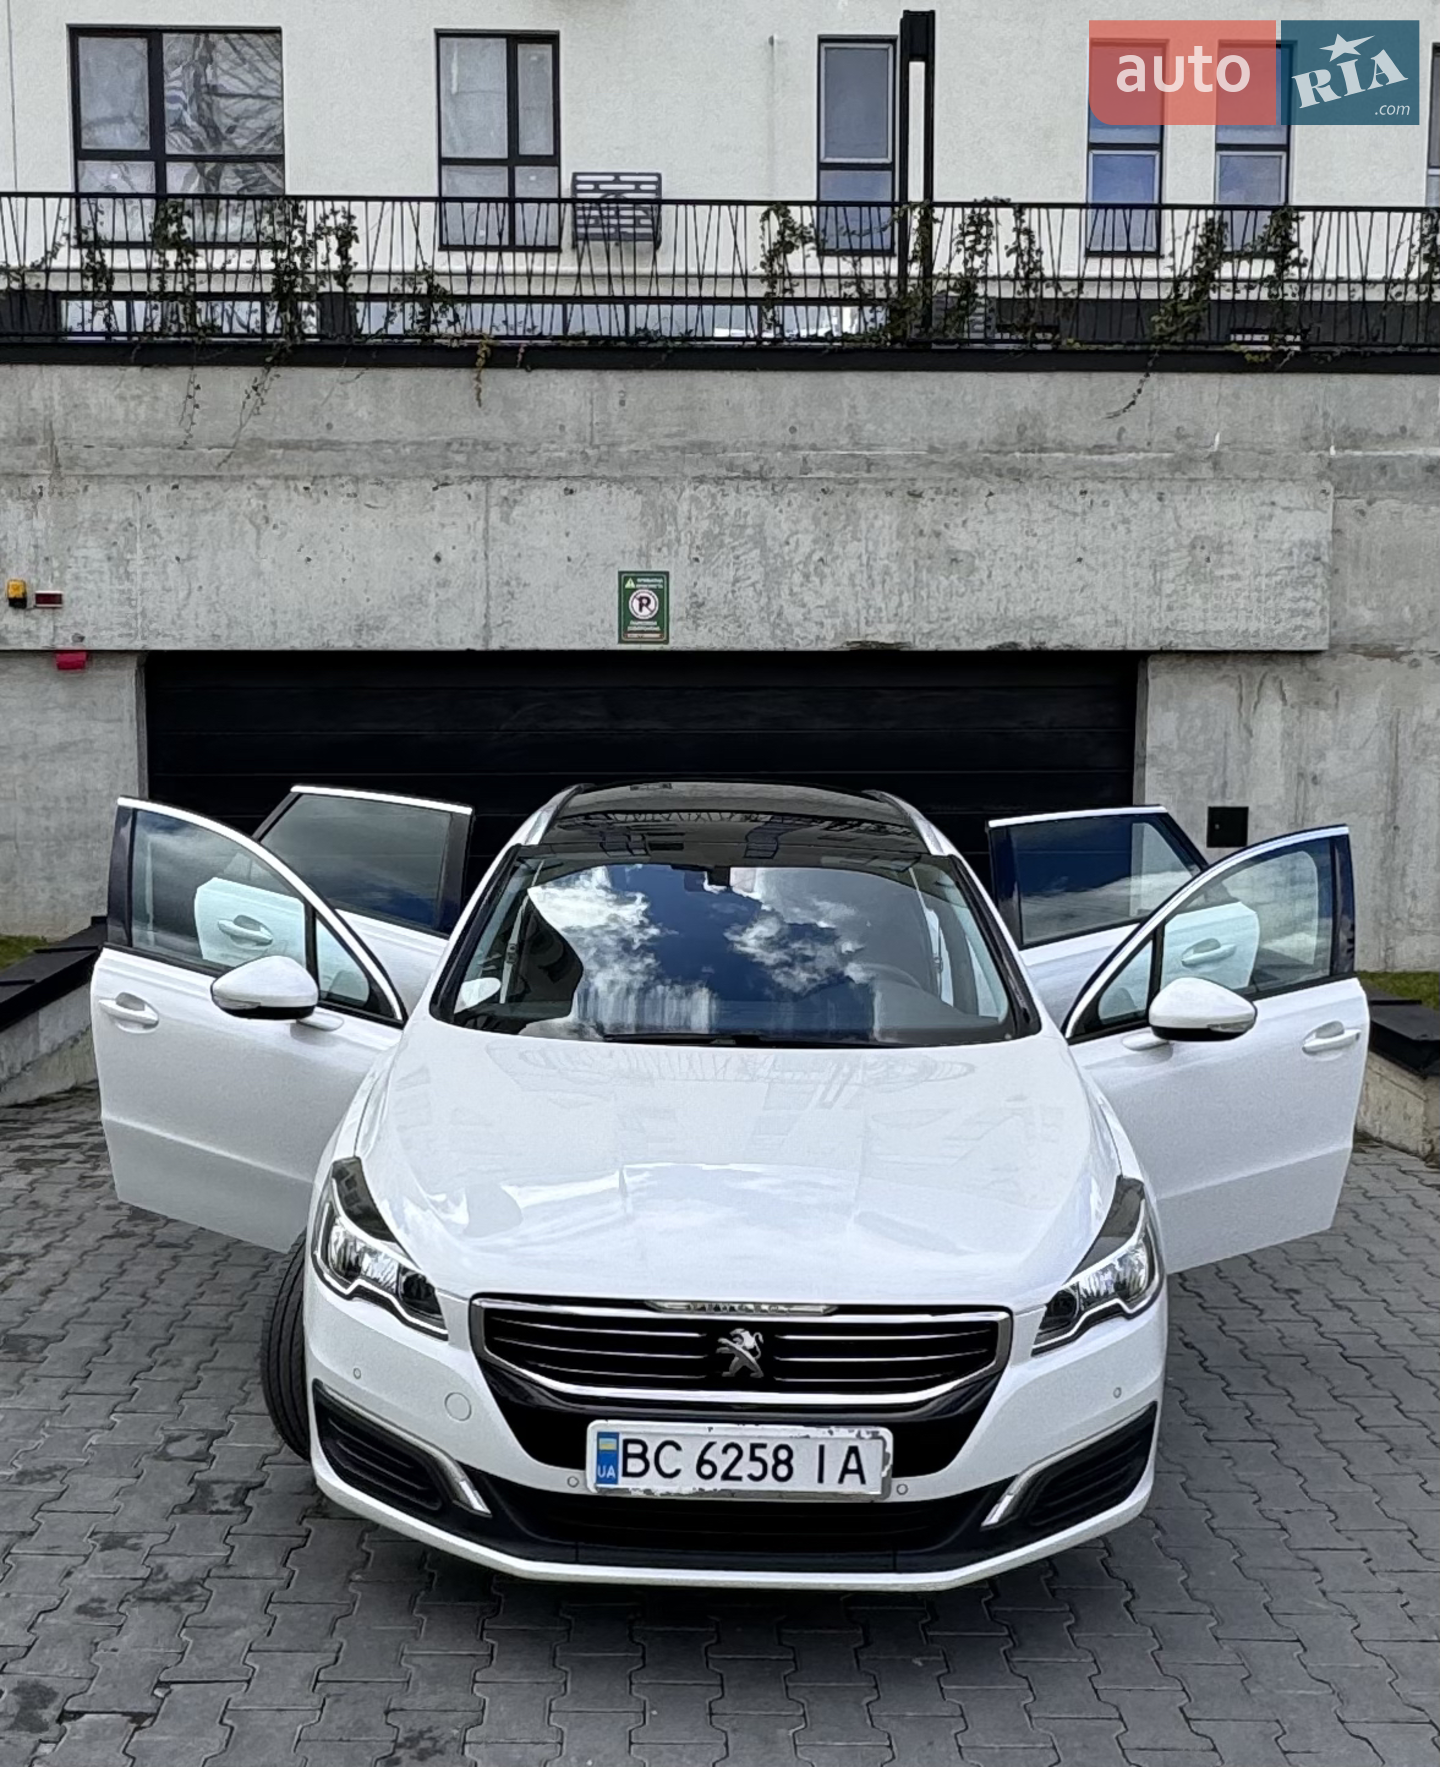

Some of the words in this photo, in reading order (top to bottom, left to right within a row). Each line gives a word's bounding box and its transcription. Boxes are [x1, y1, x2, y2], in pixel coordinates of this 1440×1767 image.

[597, 1465, 616, 1479] UA
[621, 1438, 683, 1479] BC
[695, 1441, 793, 1482] 6258
[817, 1444, 867, 1485] IA
